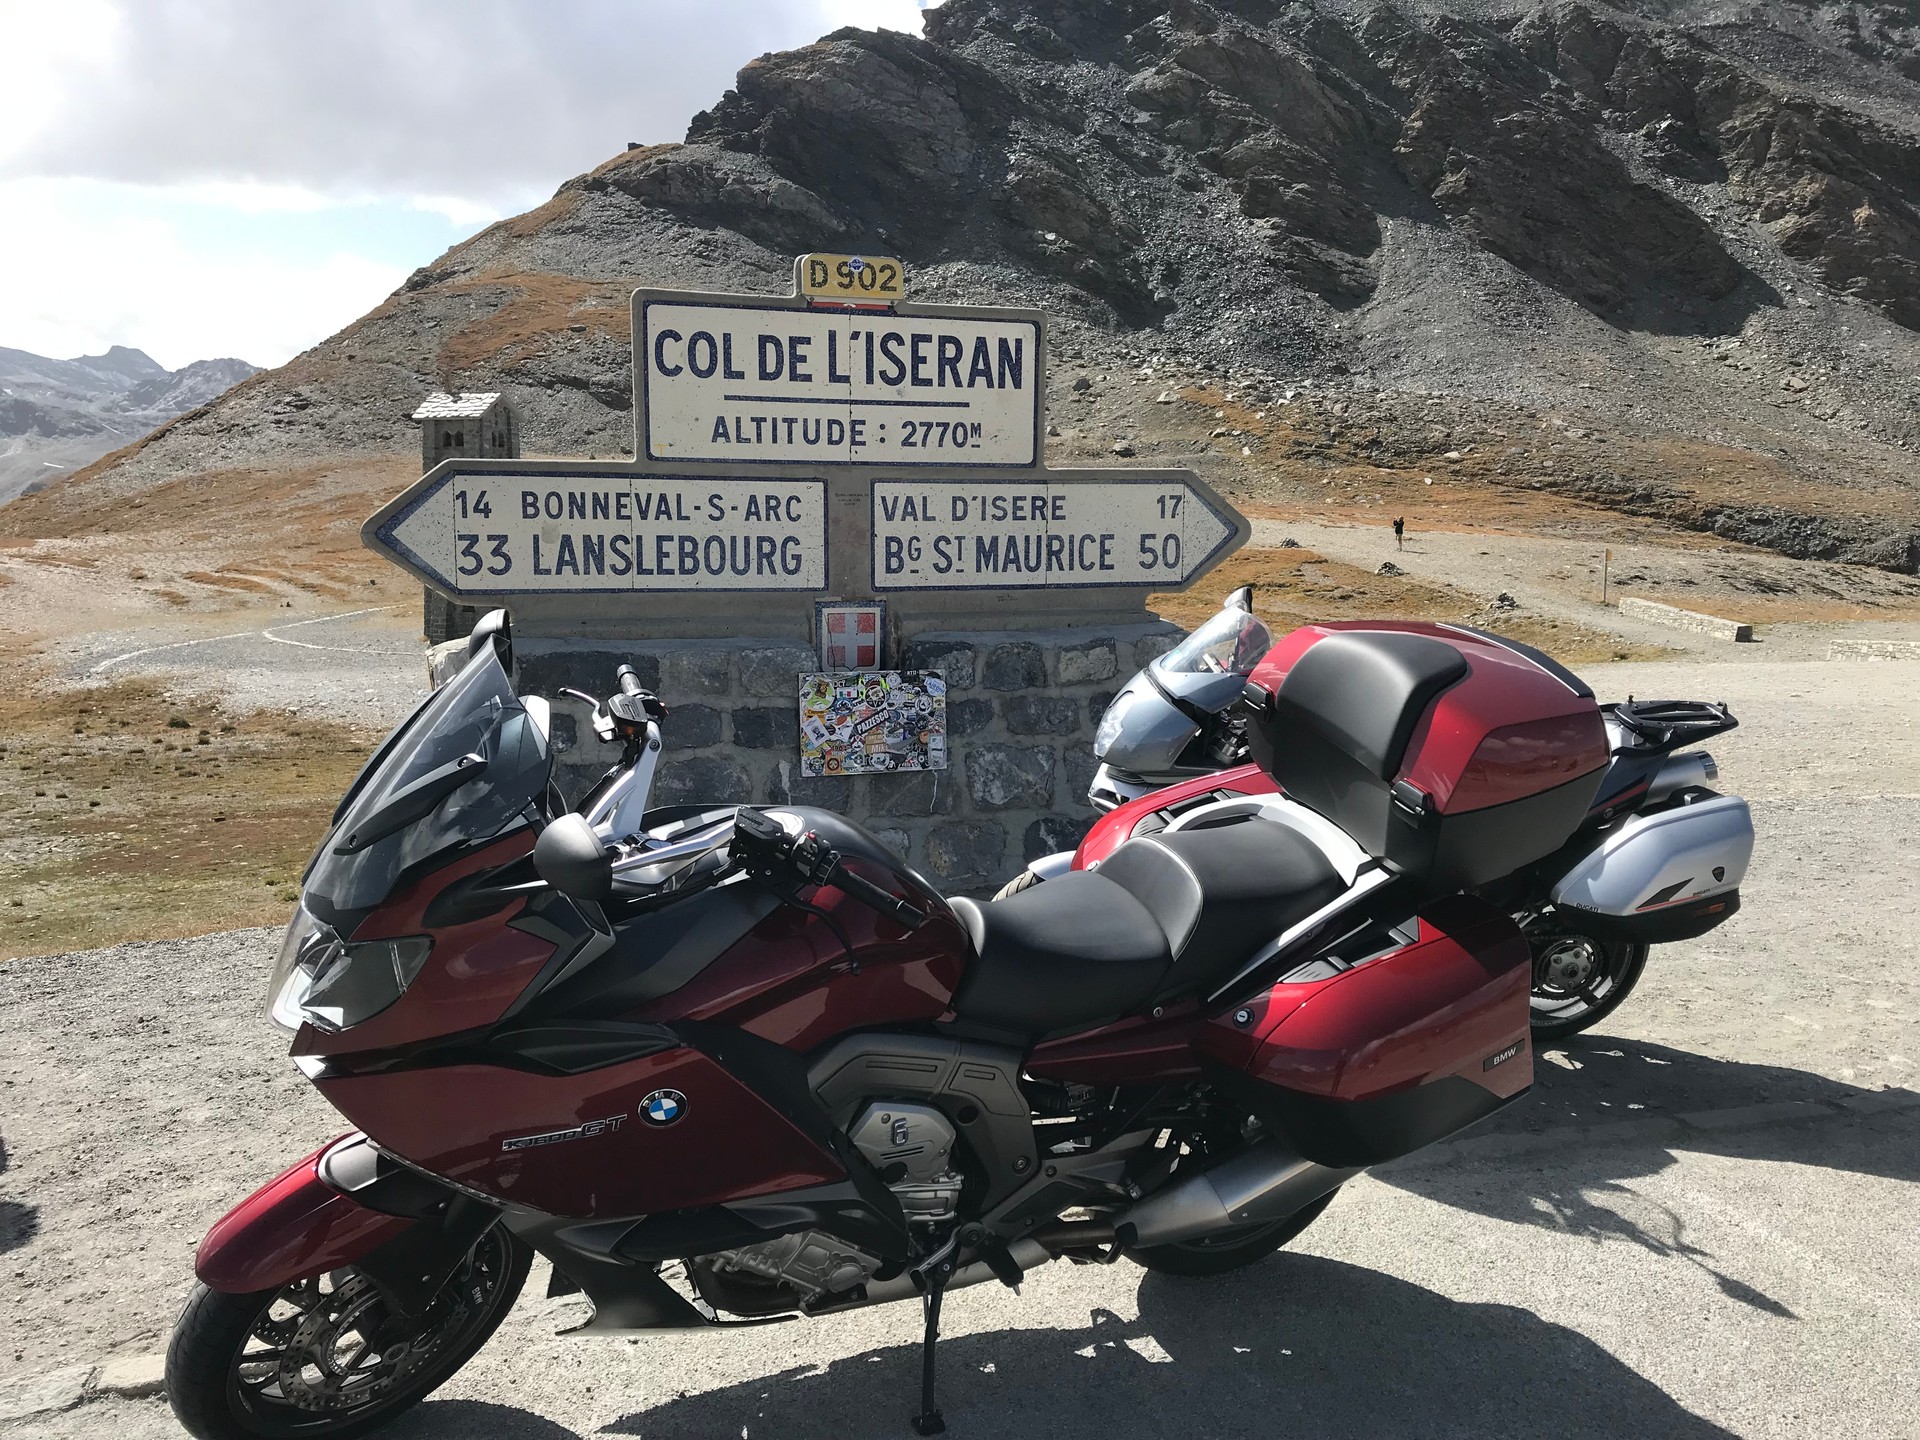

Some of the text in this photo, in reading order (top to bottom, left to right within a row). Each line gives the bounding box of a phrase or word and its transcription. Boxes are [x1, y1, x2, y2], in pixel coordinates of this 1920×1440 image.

[810, 260, 898, 292] D 902
[654, 329, 1023, 390] COL DE L'ISERAN
[711, 415, 867, 447] ALTITUDE
[455, 490, 492, 519] 14
[522, 490, 802, 522] BONNEVAL-S-ARC
[880, 495, 937, 522] VAL
[951, 495, 1067, 522] D'ISERE
[1156, 494, 1182, 520] 17
[457, 533, 803, 577] 33 LANSLEBOURG
[975, 533, 1116, 573] MAURICE
[1138, 533, 1181, 570] 50
[857, 708, 890, 734] PAZZESCO
[1576, 902, 1599, 912] DUCATI
[1493, 1047, 1517, 1065] BMW
[642, 1092, 680, 1108] BMW
[892, 1117, 909, 1147] 6
[471, 1286, 483, 1305] BMW
